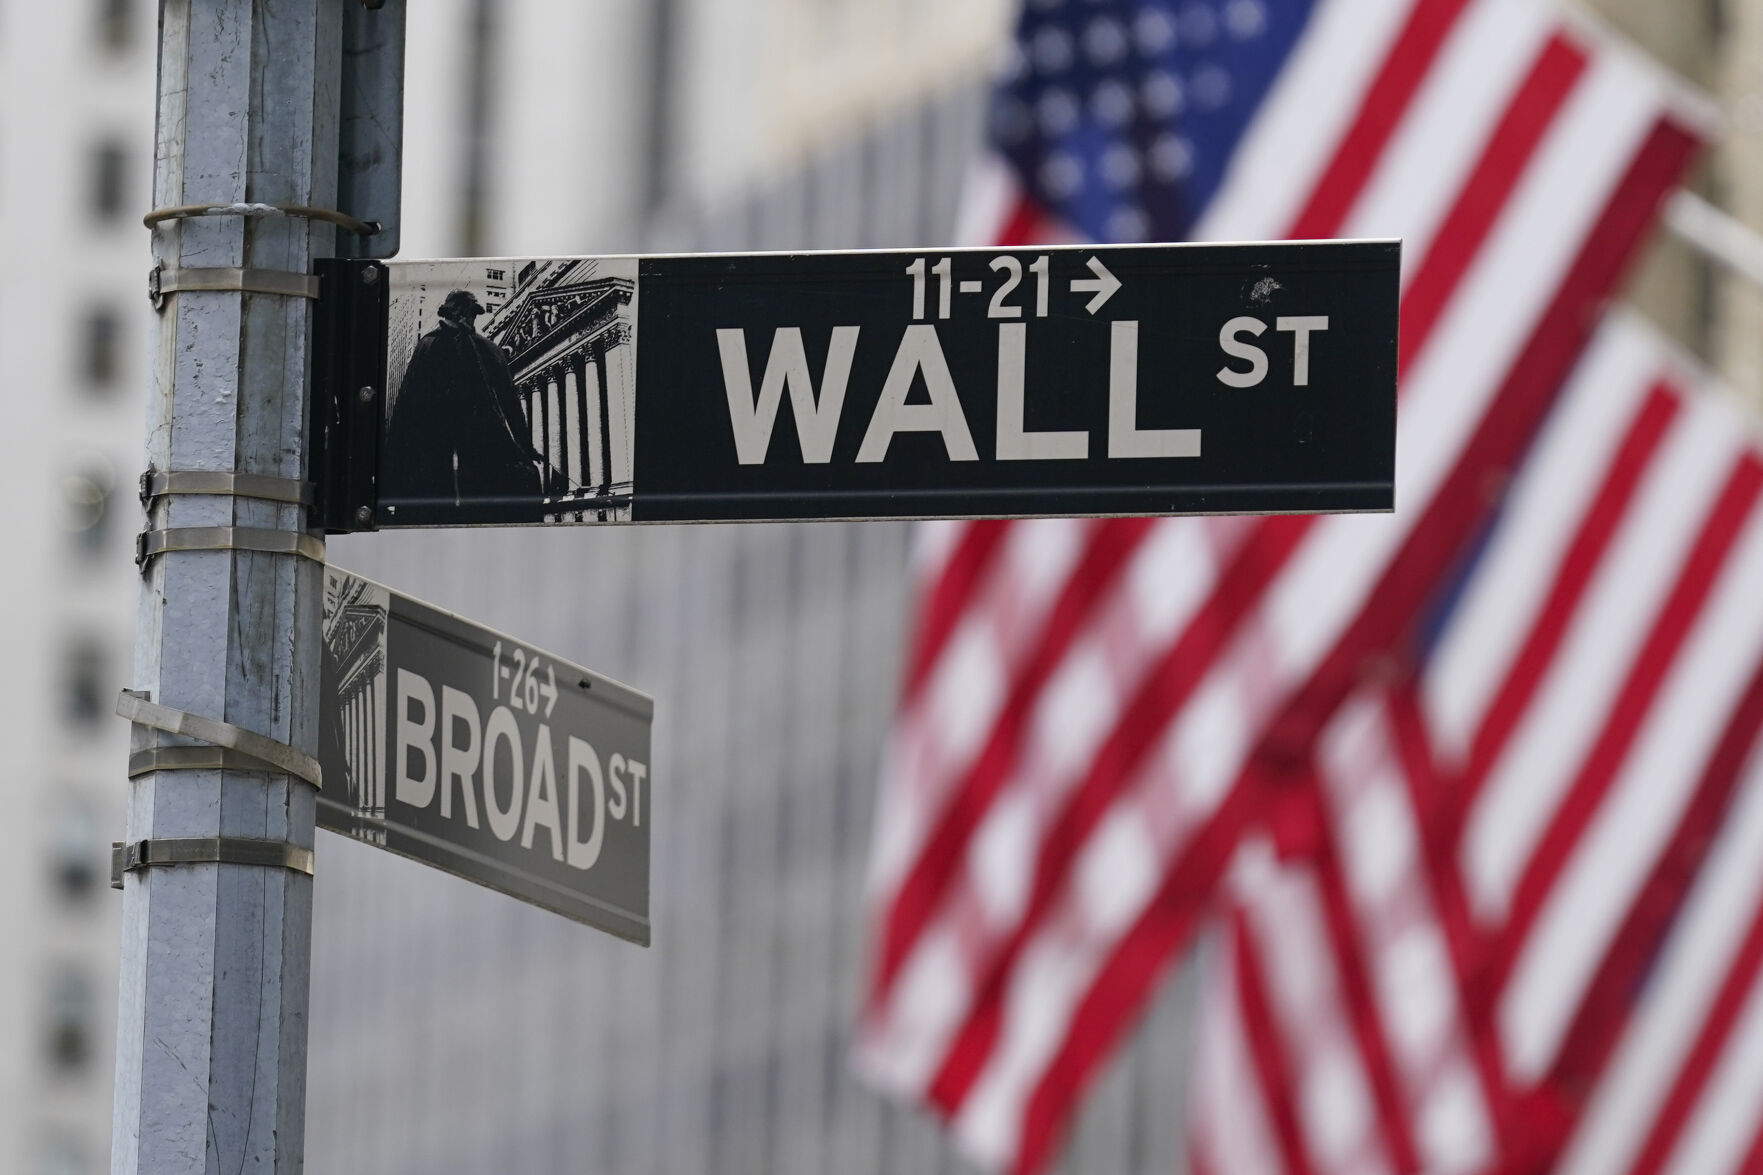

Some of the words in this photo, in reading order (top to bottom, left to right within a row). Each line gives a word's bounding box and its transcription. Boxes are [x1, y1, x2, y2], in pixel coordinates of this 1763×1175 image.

[905, 256, 1049, 320] 11-21
[716, 321, 1201, 464] WALL
[1215, 316, 1329, 387] ST
[493, 641, 540, 714] 1-26
[396, 668, 605, 870] BROAD
[609, 753, 647, 827] ST
